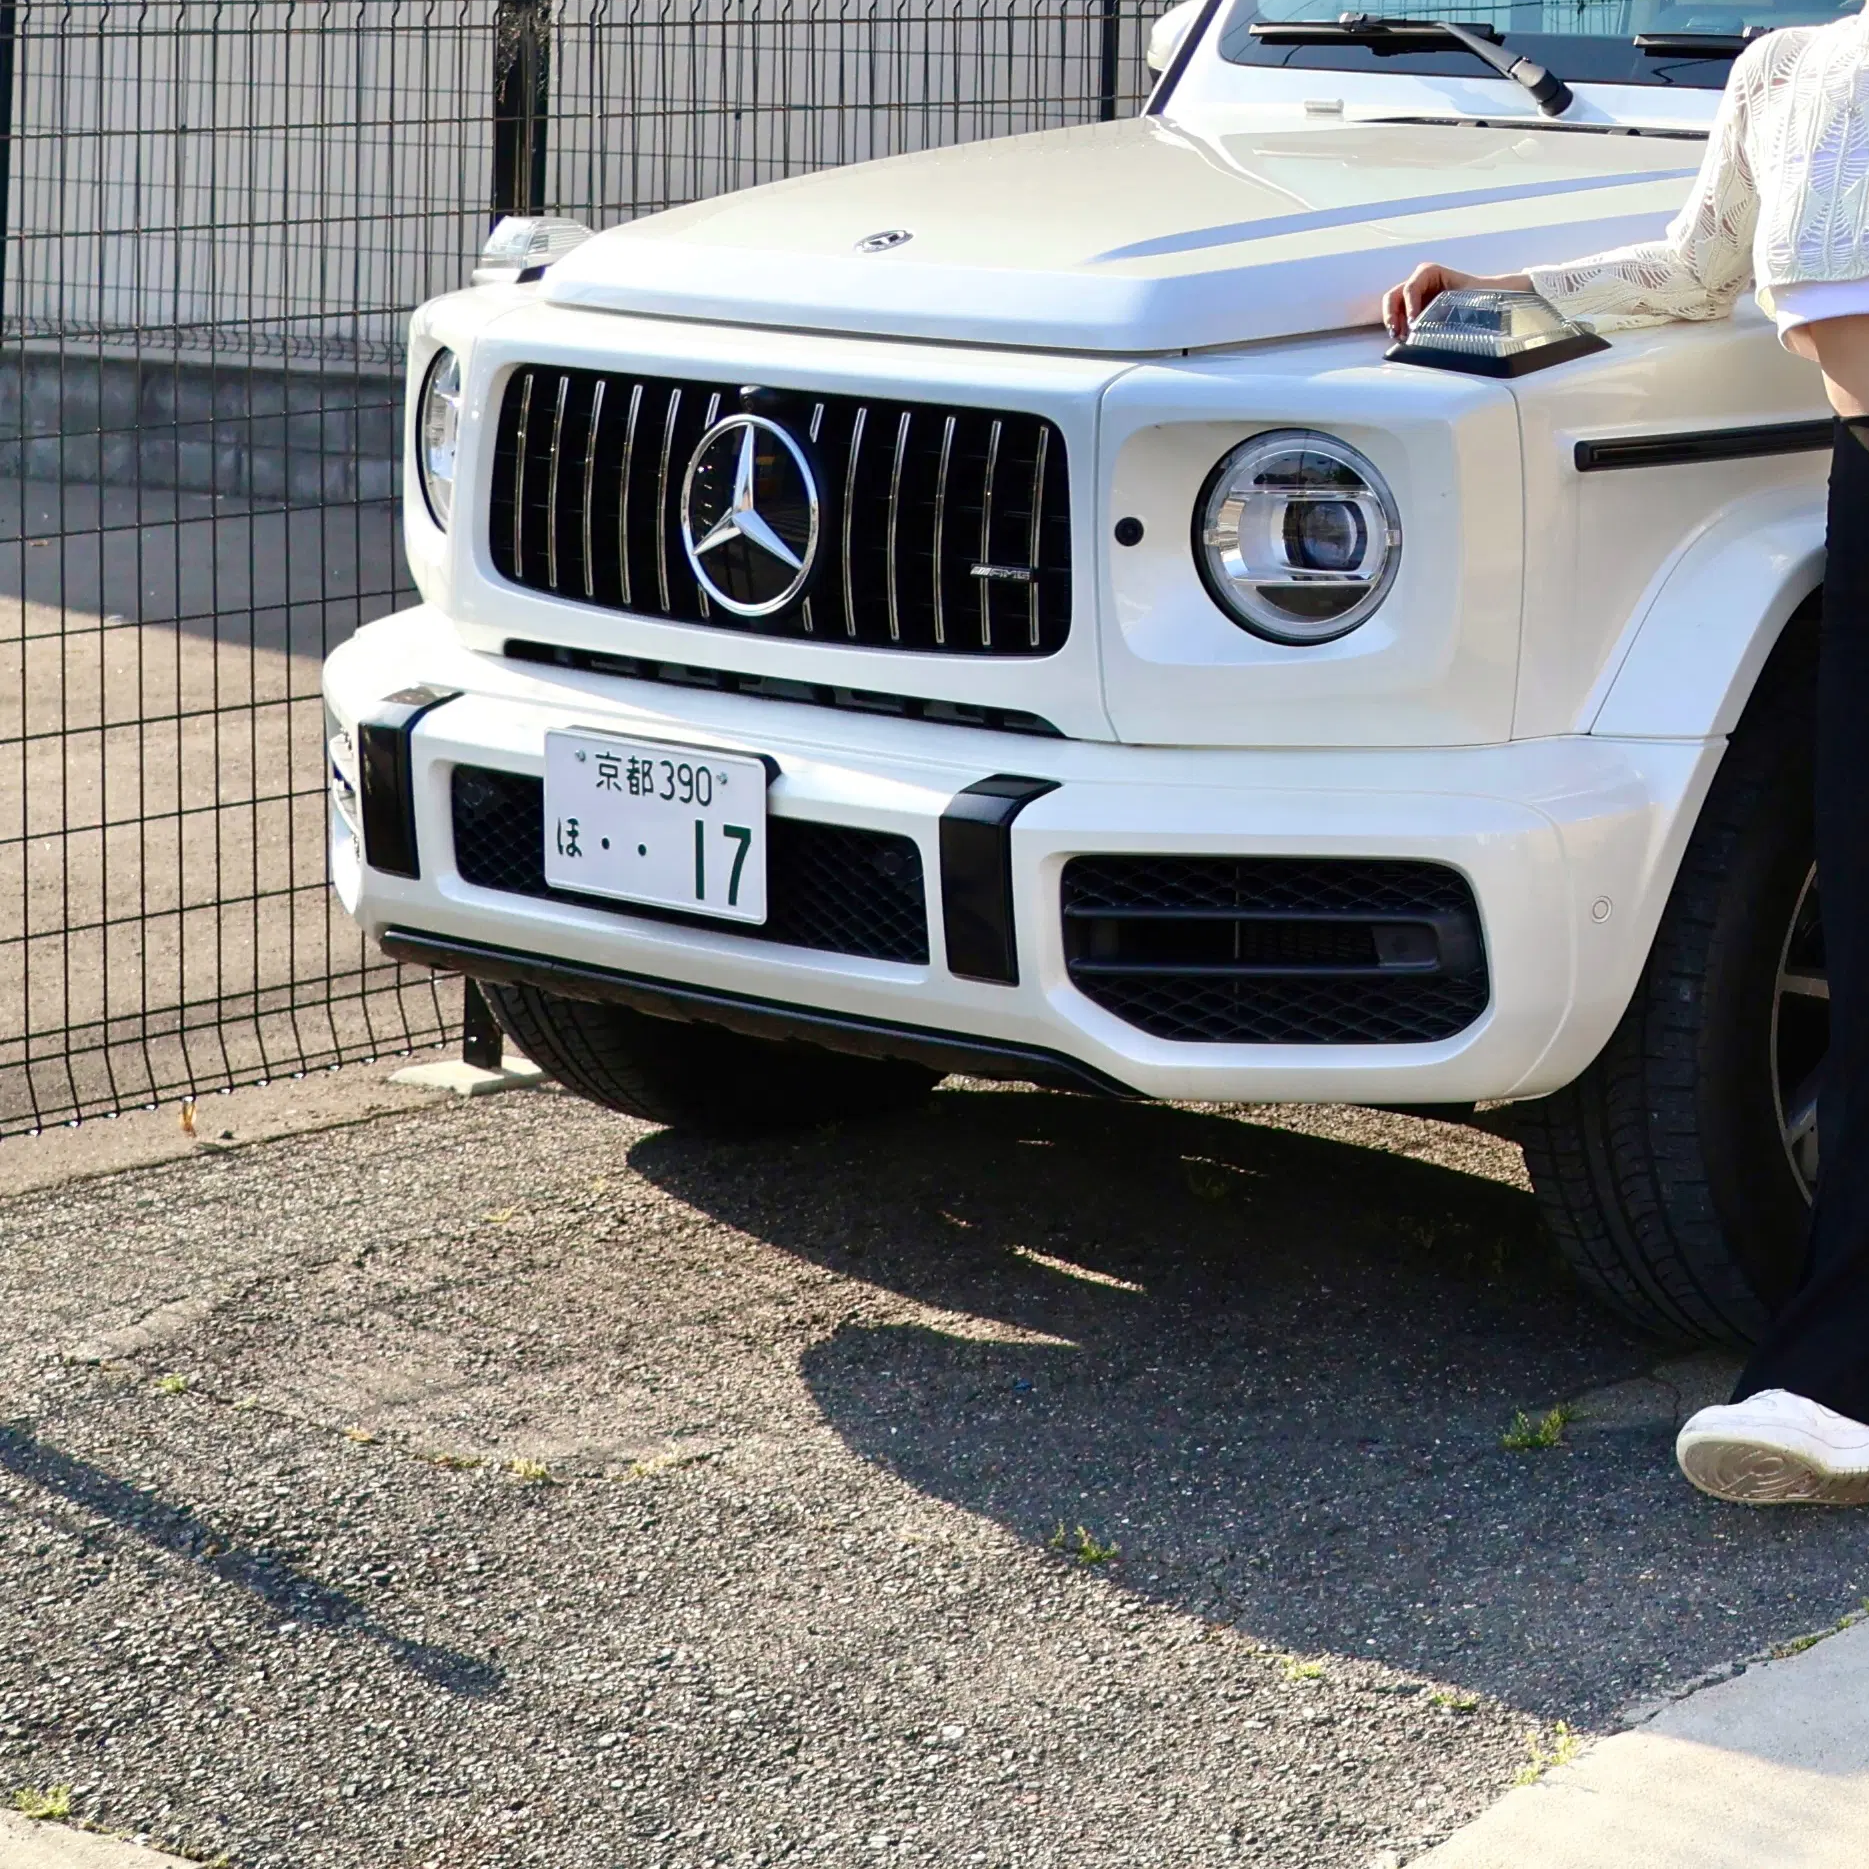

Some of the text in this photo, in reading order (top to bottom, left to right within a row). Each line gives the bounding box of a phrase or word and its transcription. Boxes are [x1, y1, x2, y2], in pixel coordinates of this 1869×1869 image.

[594, 750, 713, 808] 京都390
[556, 816, 584, 859] ほ
[694, 818, 753, 907] 17
